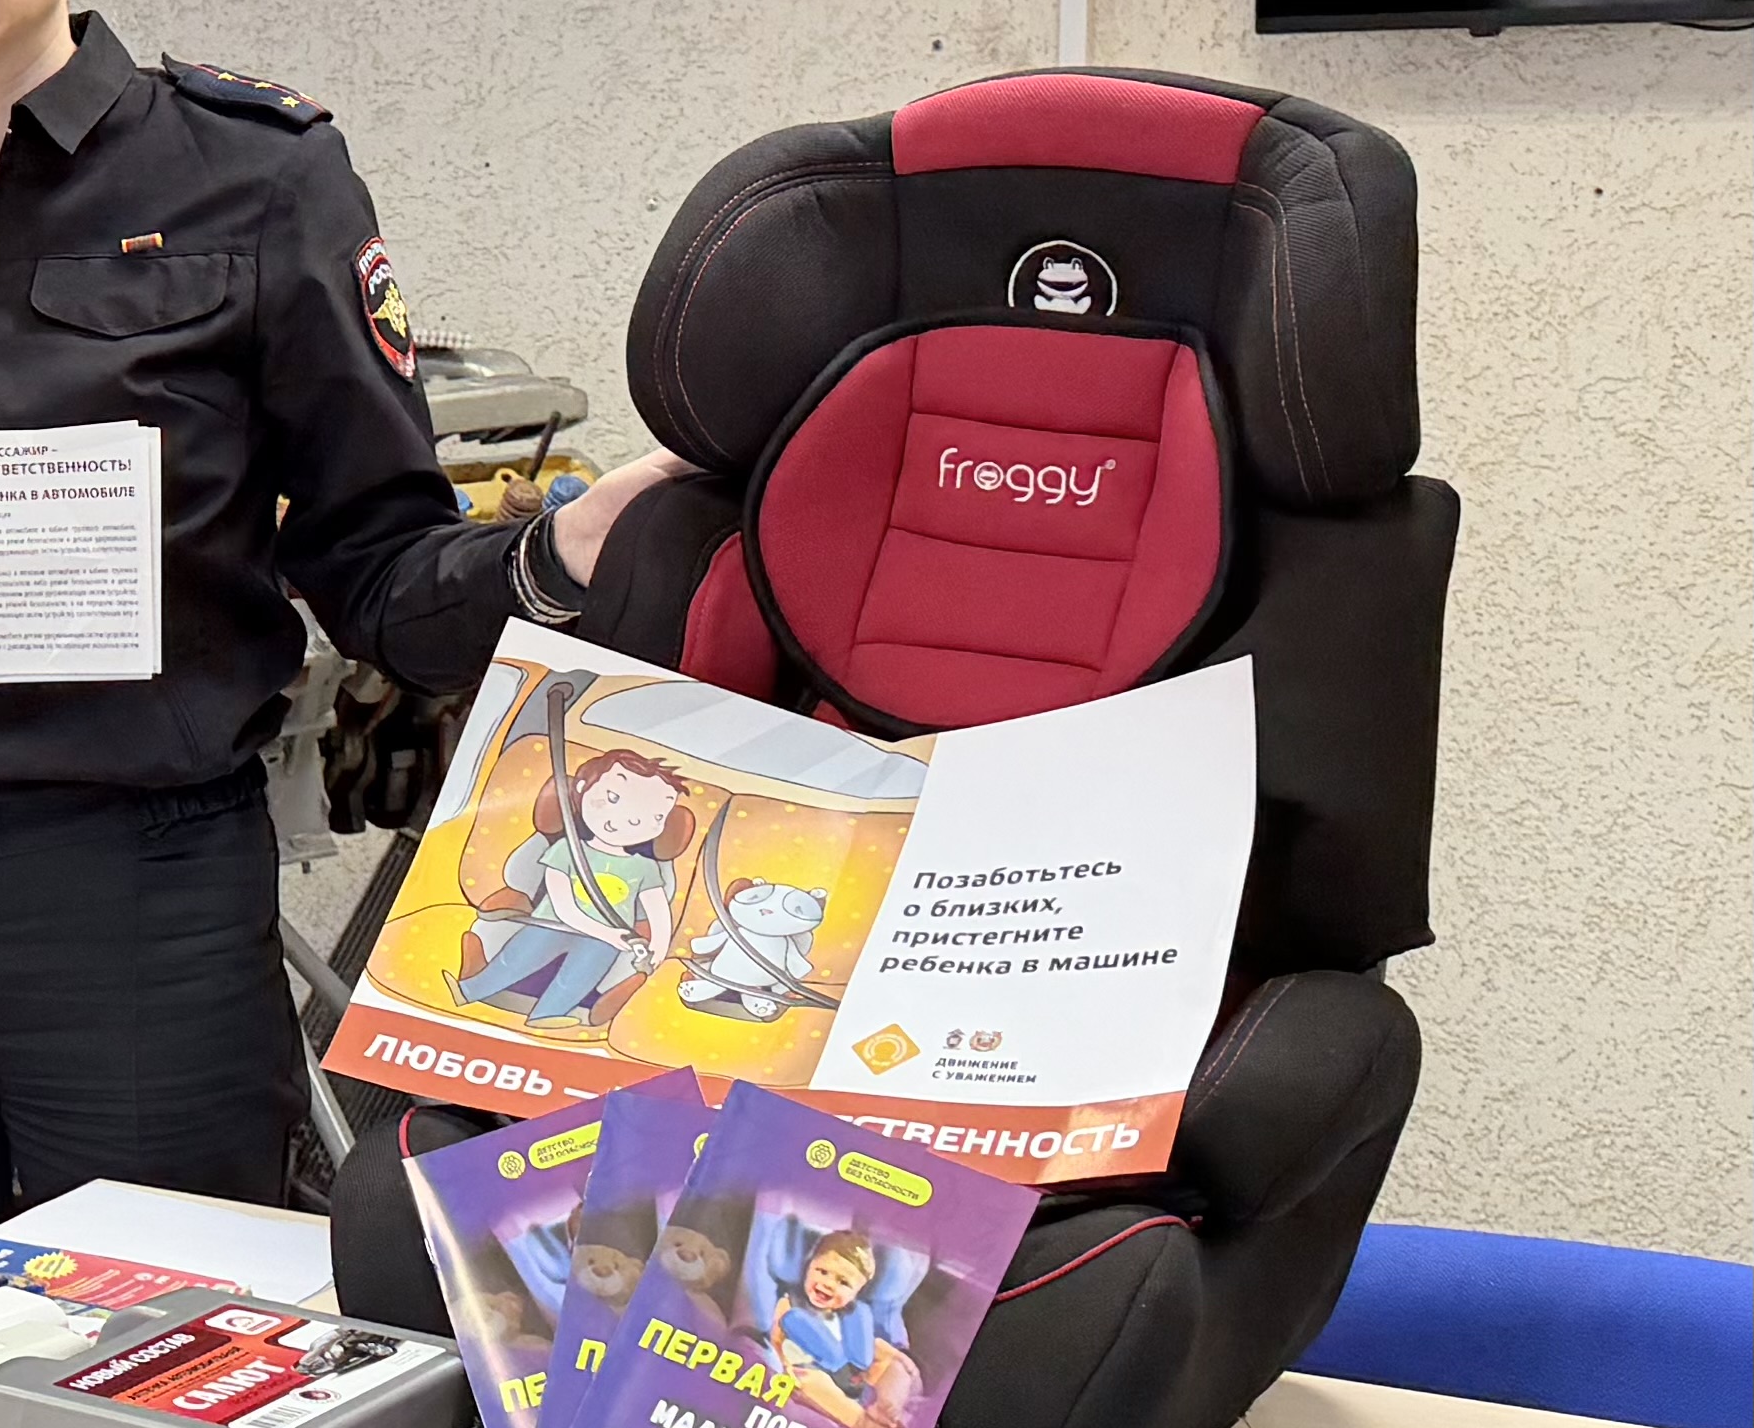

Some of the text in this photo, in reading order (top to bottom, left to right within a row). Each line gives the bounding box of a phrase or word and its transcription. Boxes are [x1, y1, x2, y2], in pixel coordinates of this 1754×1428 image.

[939, 447, 1103, 506] froggy
[31, 490, 39, 501] В
[42, 486, 135, 500] АВТОМОБИЛЕ
[912, 860, 1122, 890] Позаботьтесь
[903, 896, 1063, 919] о близких,
[892, 925, 1084, 948] пристегните
[879, 948, 1178, 976] ребенка в машине
[363, 1033, 553, 1096] ЛЮБОВЬ
[931, 1070, 1037, 1084] С УВАЖЕНИЕМ
[935, 1057, 1019, 1071] ДВИЖЕНИЕ
[69, 1333, 196, 1391] НОВЫЙ СОСТАВ
[637, 1317, 797, 1410] ПЕРВАЯ
